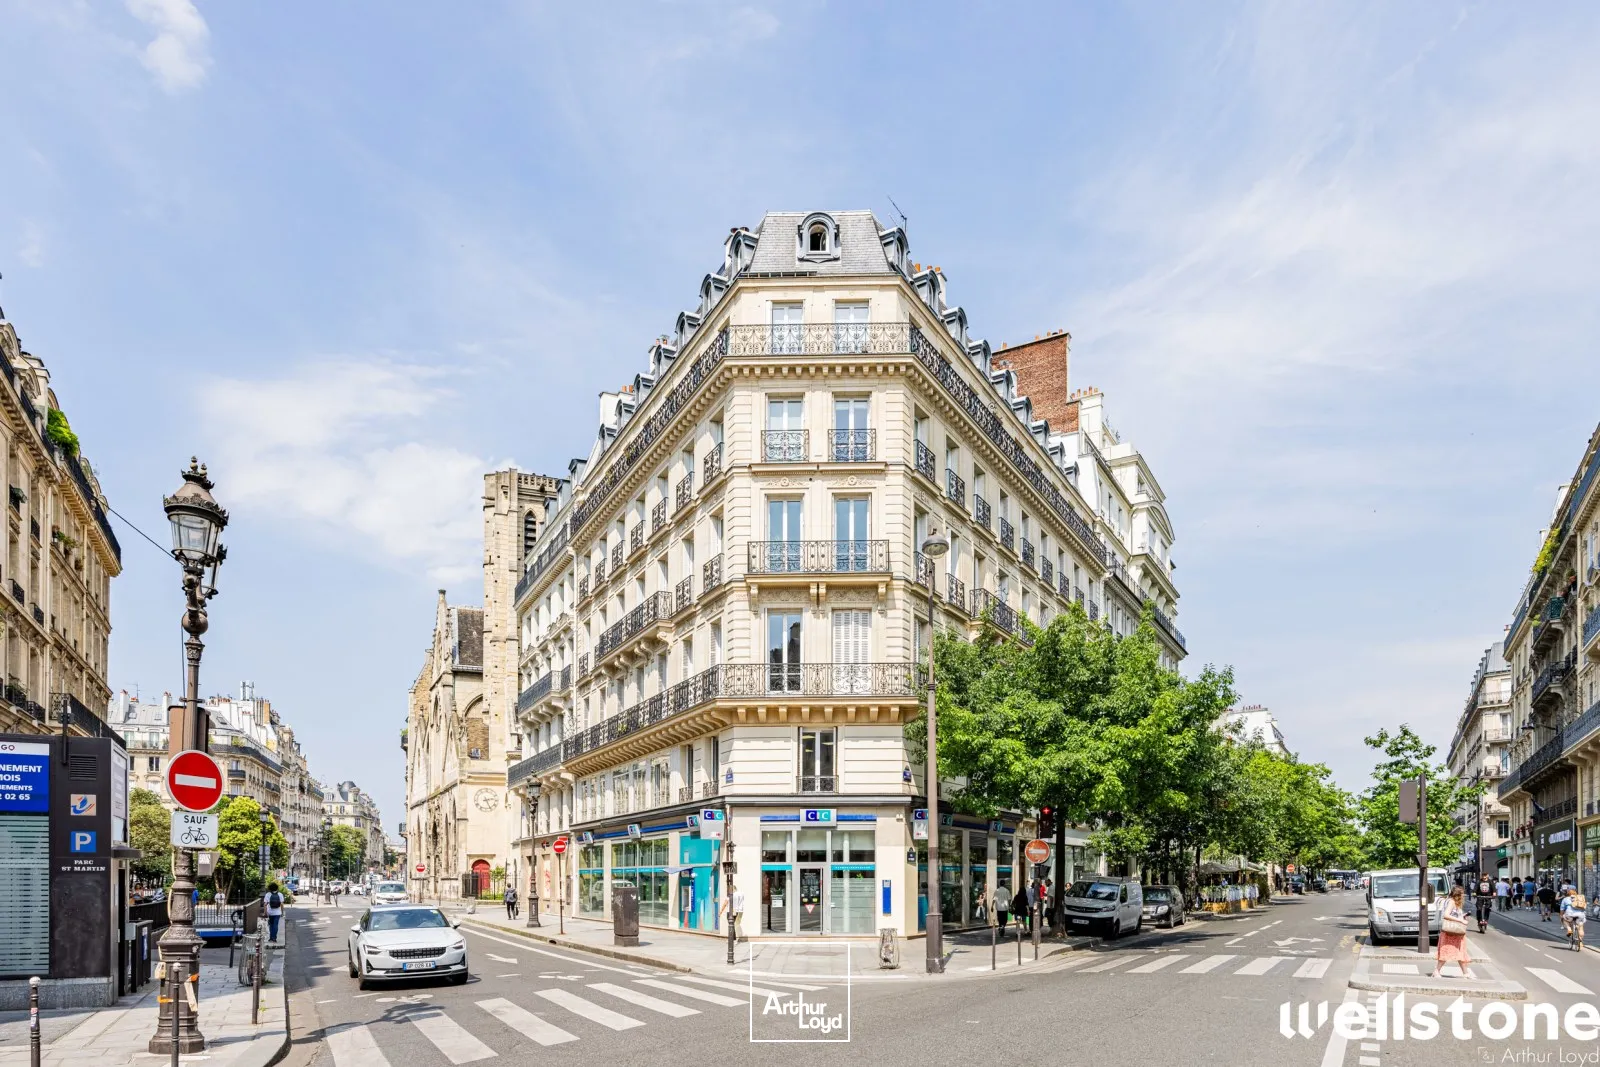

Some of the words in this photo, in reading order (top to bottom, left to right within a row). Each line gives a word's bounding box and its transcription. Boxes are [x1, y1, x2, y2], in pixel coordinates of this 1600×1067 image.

[183, 815, 208, 824] SAUF
[704, 811, 723, 820] CIC
[806, 811, 830, 821] CIC
[75, 832, 92, 851] P
